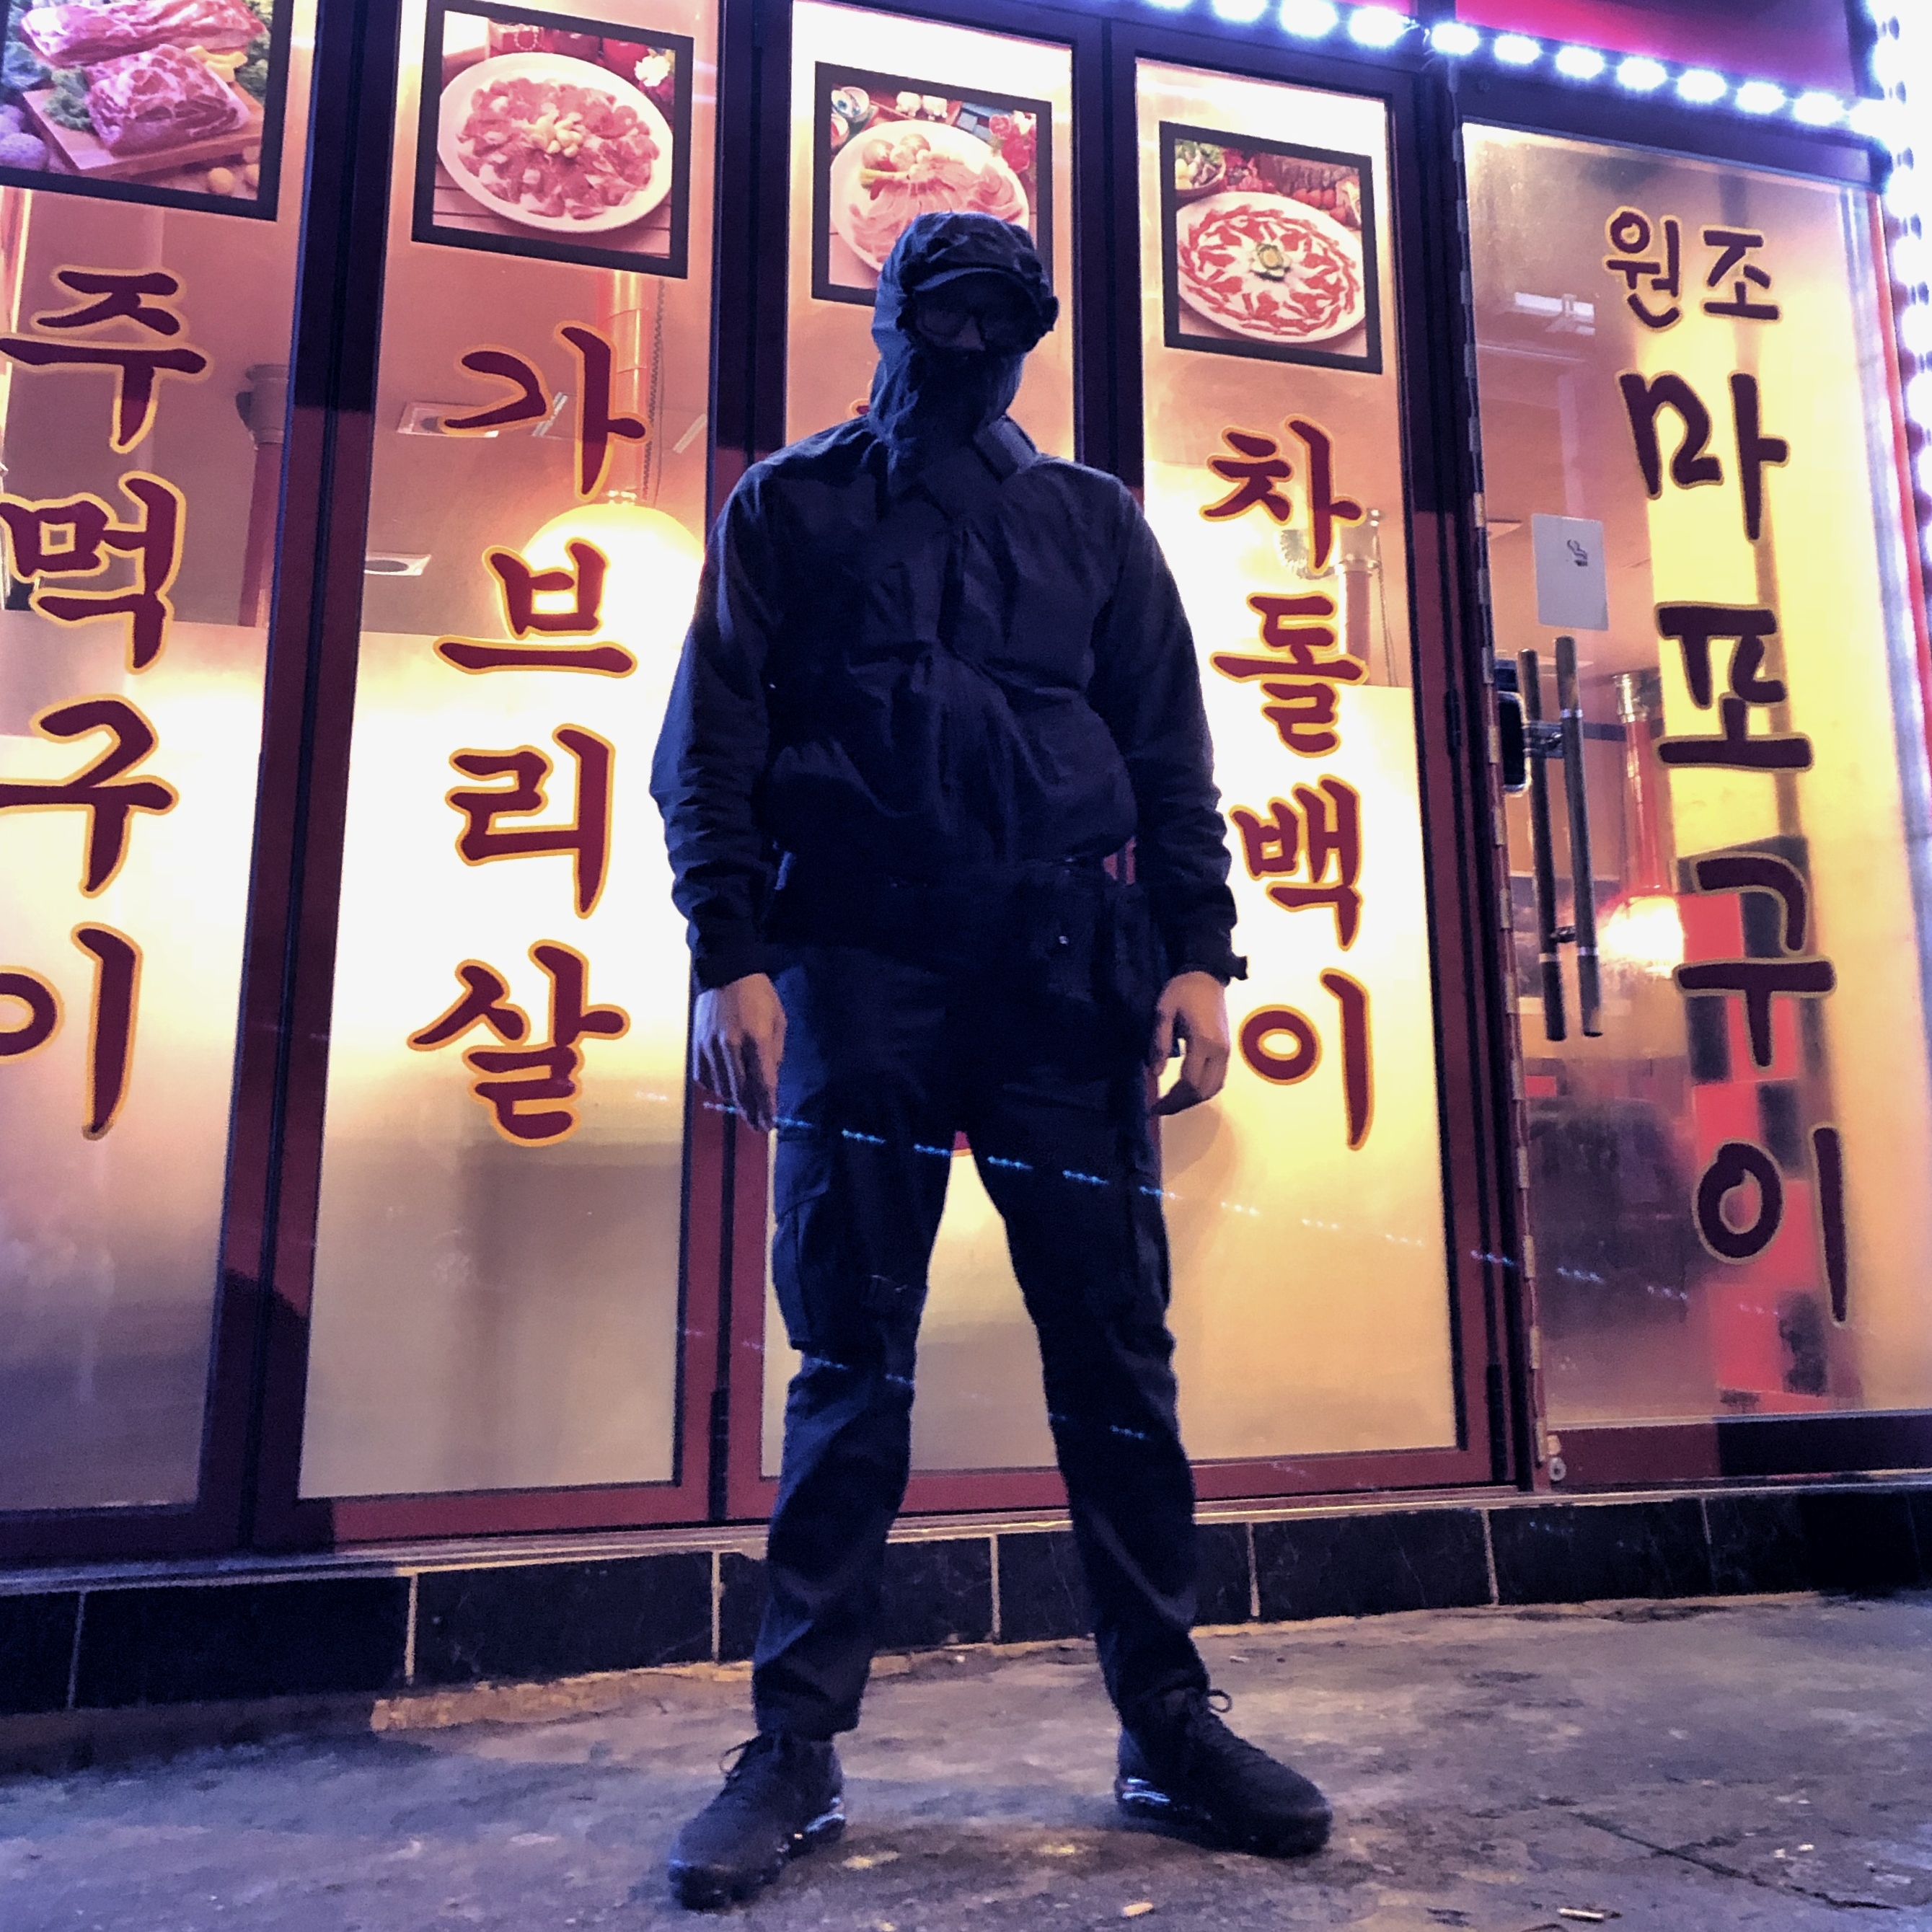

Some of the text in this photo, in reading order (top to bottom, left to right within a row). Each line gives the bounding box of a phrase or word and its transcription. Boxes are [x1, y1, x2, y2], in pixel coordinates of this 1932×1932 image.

[1603, 206, 1781, 332] 원조
[0, 268, 206, 1139] 주먹구이
[409, 322, 648, 1147] 가브리살
[1200, 415, 1375, 1152] 차돌백이
[1615, 369, 1848, 1326] 마포구이
